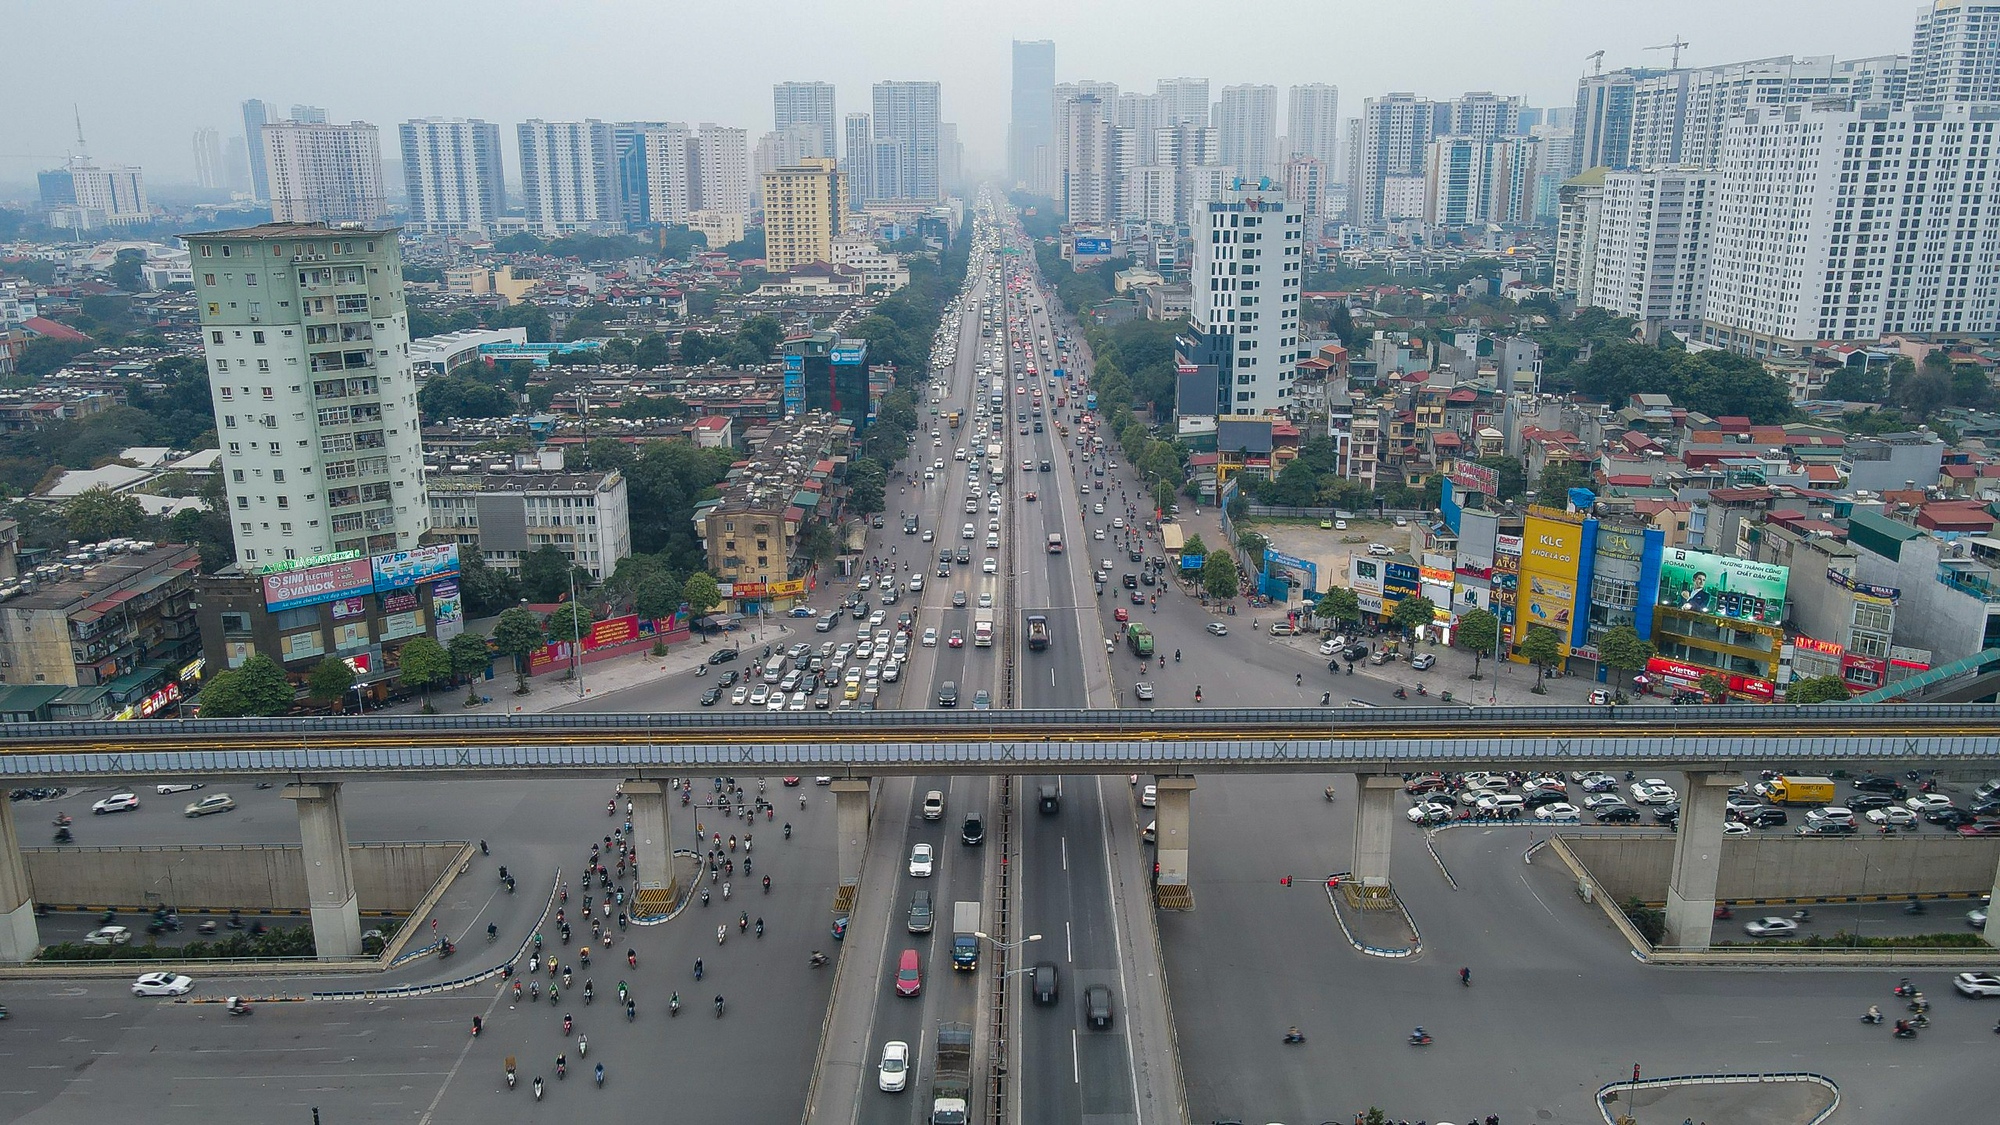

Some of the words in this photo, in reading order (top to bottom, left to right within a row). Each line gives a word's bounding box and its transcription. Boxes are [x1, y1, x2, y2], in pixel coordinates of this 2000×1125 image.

[1540, 535, 1563, 548] KLC
[1496, 559, 1516, 568] ATG
[1664, 560, 1695, 570] ROMANO
[1720, 560, 1742, 568] HƯƠNG
[1744, 564, 1764, 572] THÀNH
[1765, 567, 1782, 575] CÔNG
[282, 573, 304, 585] SINO
[305, 570, 334, 581] ELECTRIC
[291, 581, 336, 596] VANLOCK
[1384, 584, 1417, 594] GOODYEAR
[1490, 590, 1516, 600] TOPY
[1796, 636, 1812, 648] HUY
[1670, 665, 1700, 678] viettel
